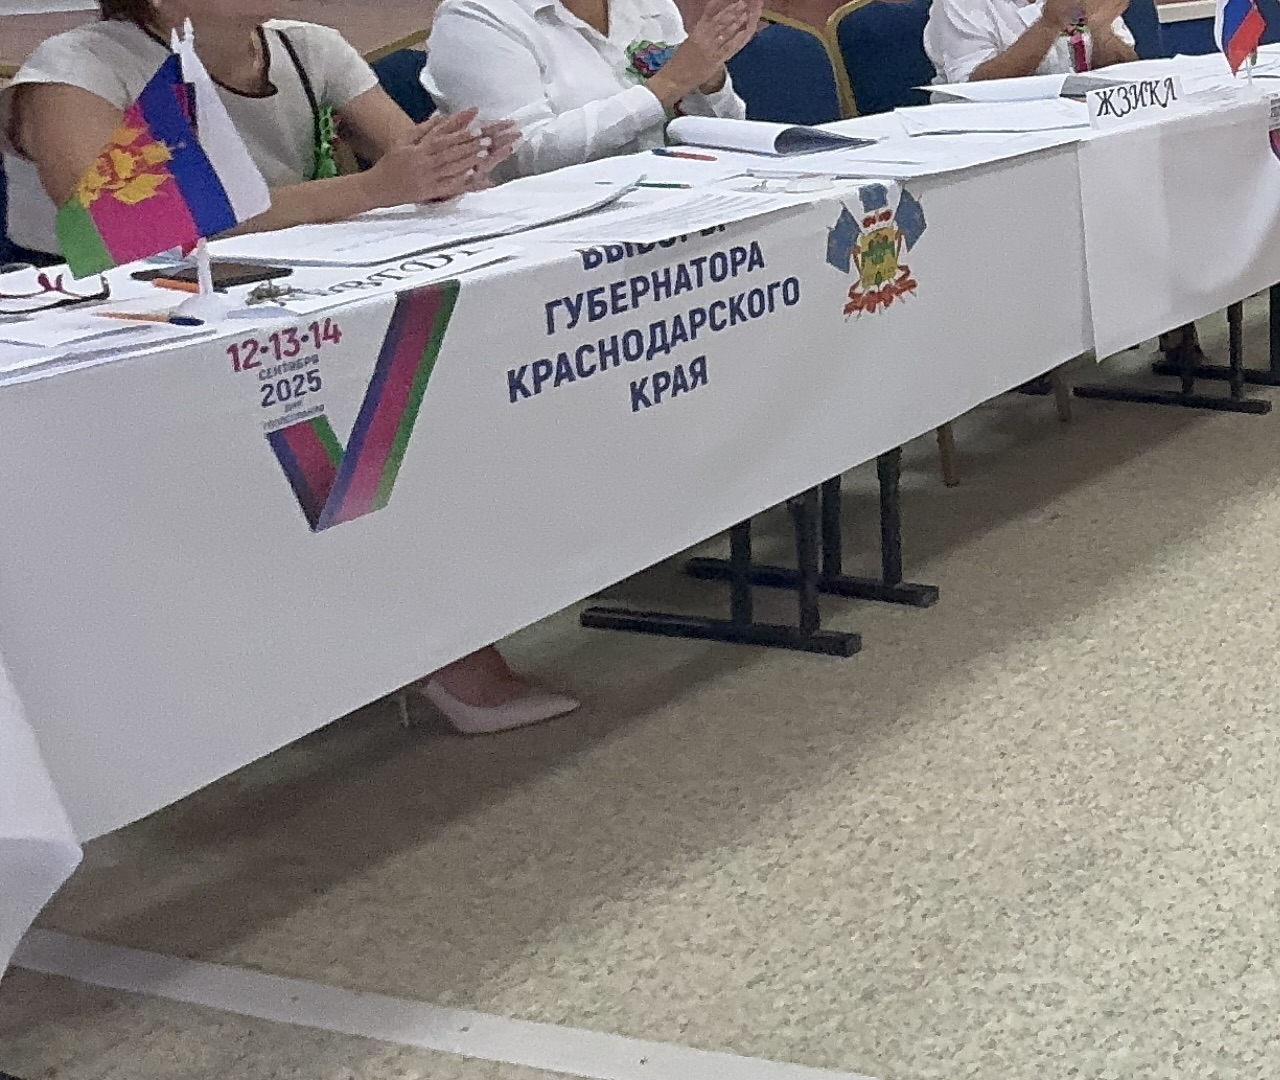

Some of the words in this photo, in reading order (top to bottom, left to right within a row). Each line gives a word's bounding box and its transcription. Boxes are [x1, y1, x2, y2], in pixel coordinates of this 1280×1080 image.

[1094, 77, 1178, 118] ЖЗИКЛ
[545, 240, 765, 336] ГУБЕРНАТОРА
[507, 276, 800, 404] КРАСНОДАРСКОГО
[260, 368, 323, 408] 2025
[629, 355, 709, 413] КРАЯ
